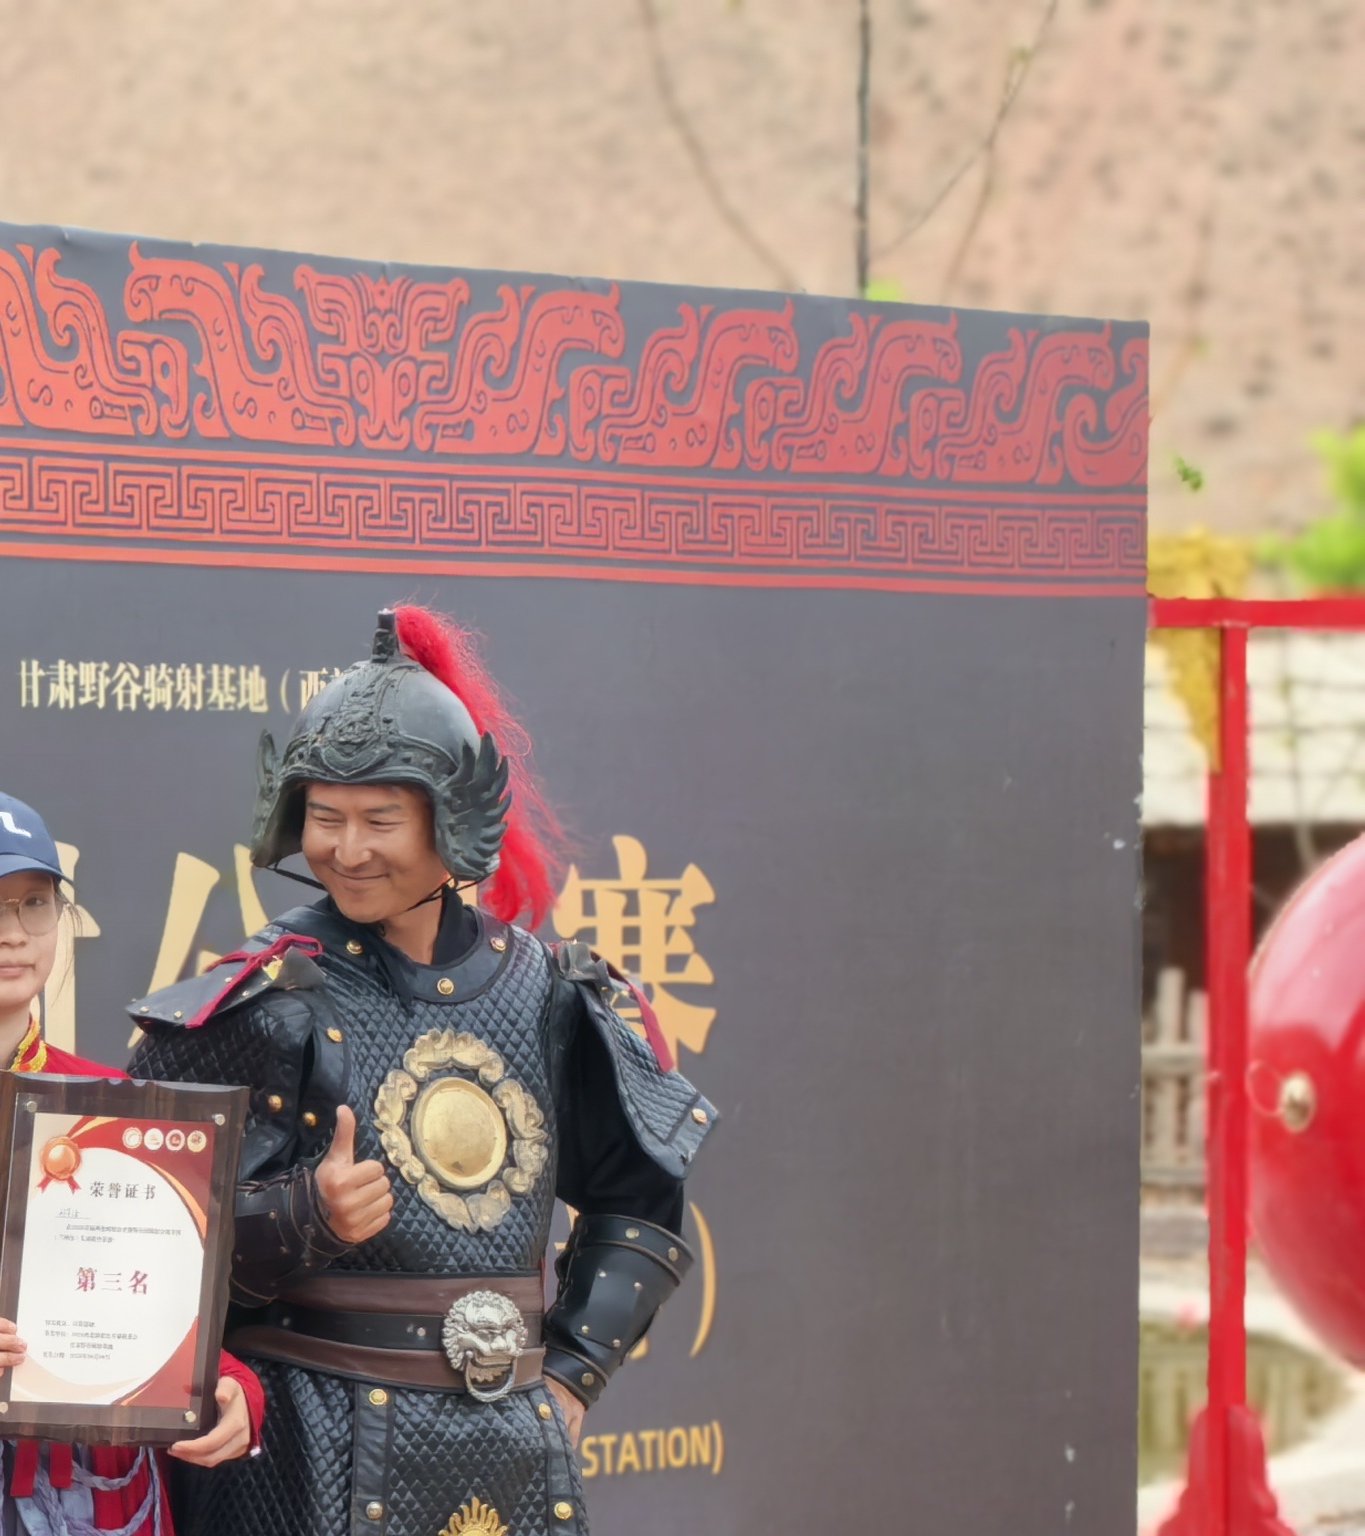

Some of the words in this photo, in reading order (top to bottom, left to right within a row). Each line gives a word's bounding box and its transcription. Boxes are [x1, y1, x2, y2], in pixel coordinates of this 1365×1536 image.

[16, 660, 345, 714] 甘肃野谷骑射基地（西
[90, 1180, 157, 1200] 荣誉证书
[76, 1266, 148, 1296] 第三名
